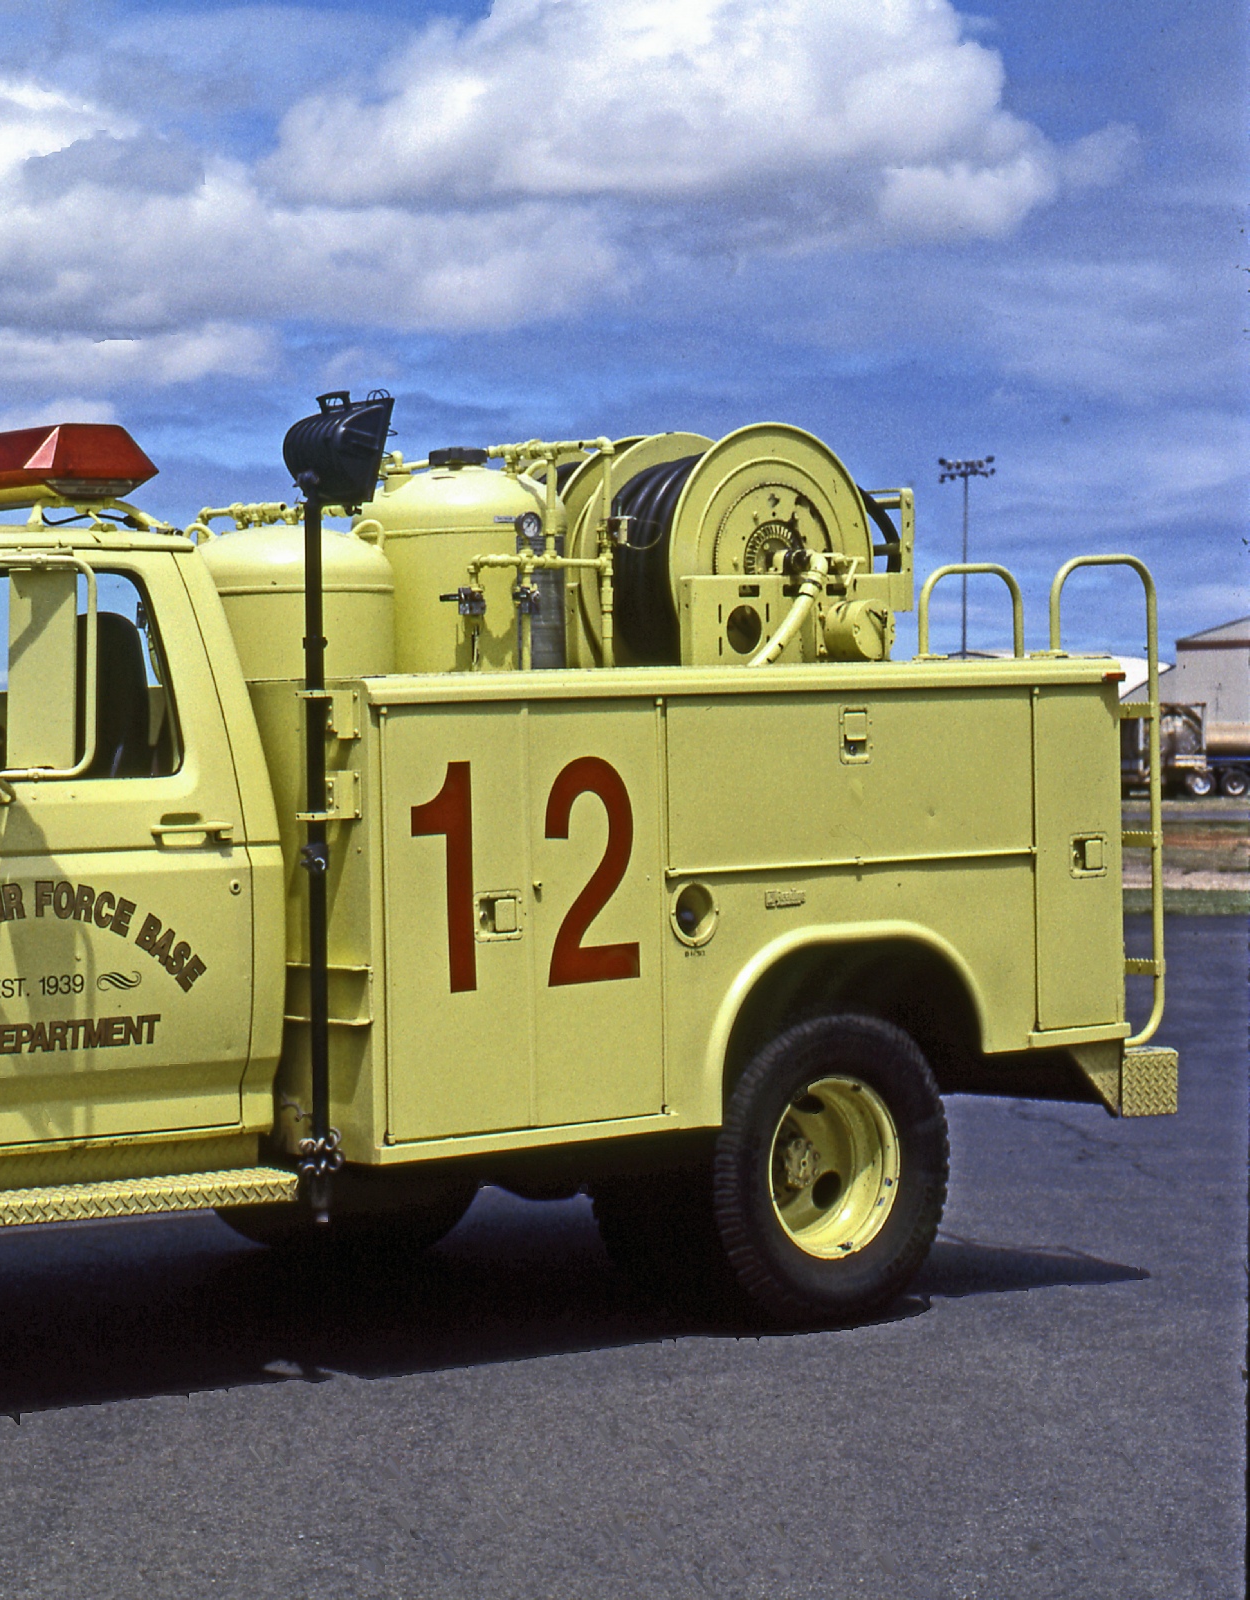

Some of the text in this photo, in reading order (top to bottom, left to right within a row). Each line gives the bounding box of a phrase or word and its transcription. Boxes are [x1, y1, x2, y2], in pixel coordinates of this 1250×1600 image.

[410, 755, 641, 994] 12
[34, 880, 138, 938] FORCE
[134, 912, 208, 993] BASE
[38, 973, 85, 996] 1939
